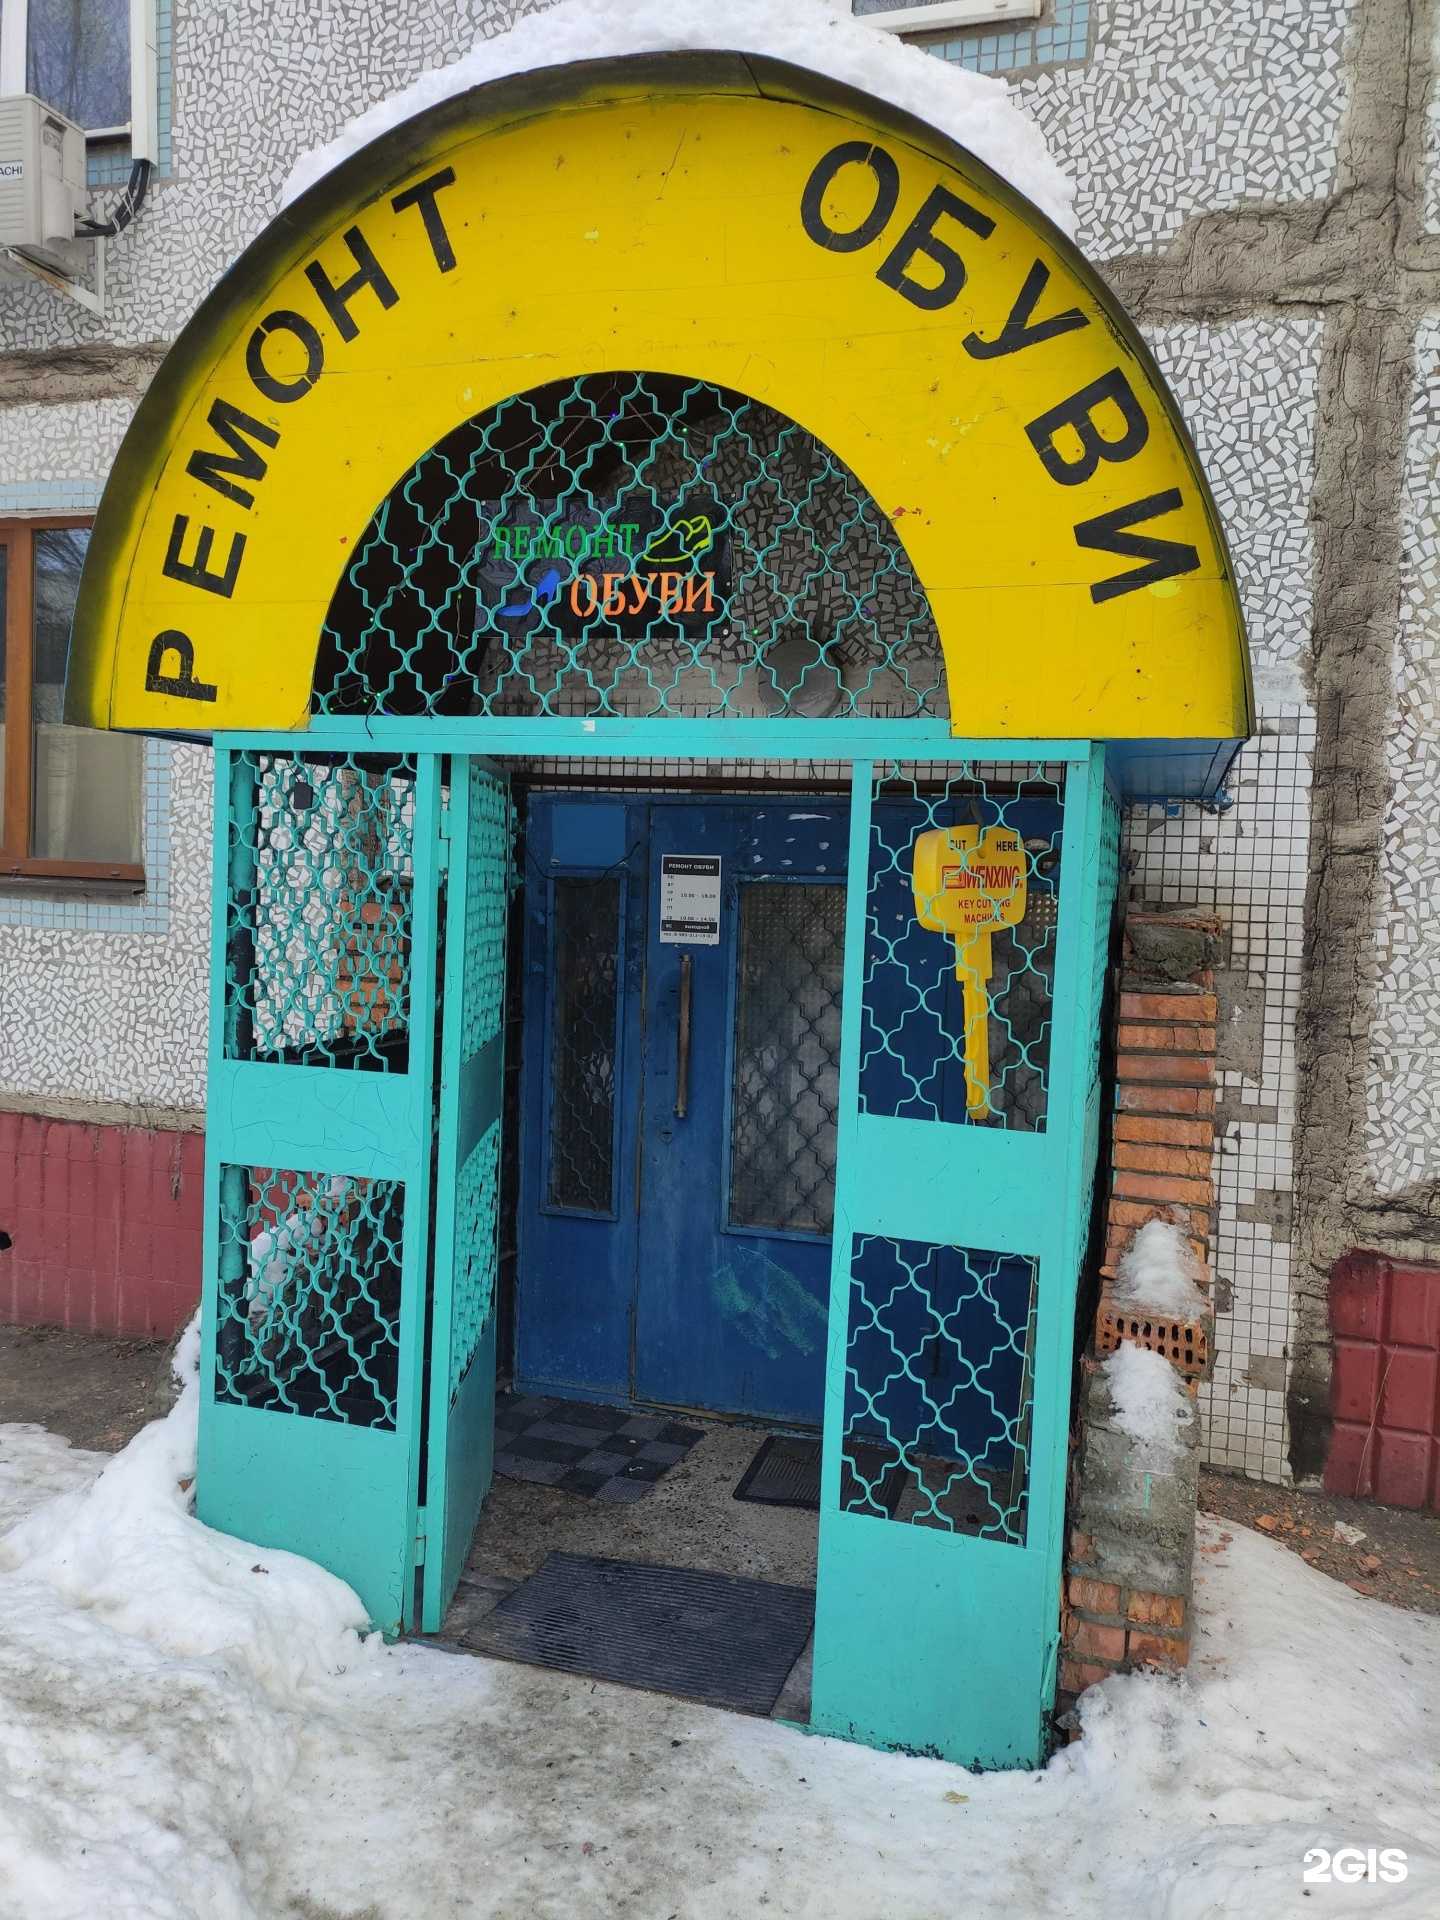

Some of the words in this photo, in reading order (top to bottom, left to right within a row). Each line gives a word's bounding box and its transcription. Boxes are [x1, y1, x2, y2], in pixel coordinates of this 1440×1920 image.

[145, 166, 457, 702] РЕМОНТ
[800, 141, 1201, 604] ОБУВИ
[492, 523, 640, 560] РЕМОНТ
[570, 571, 716, 617] ОБУВИ
[996, 840, 1019, 852] HERE
[958, 899, 975, 909] KEY
